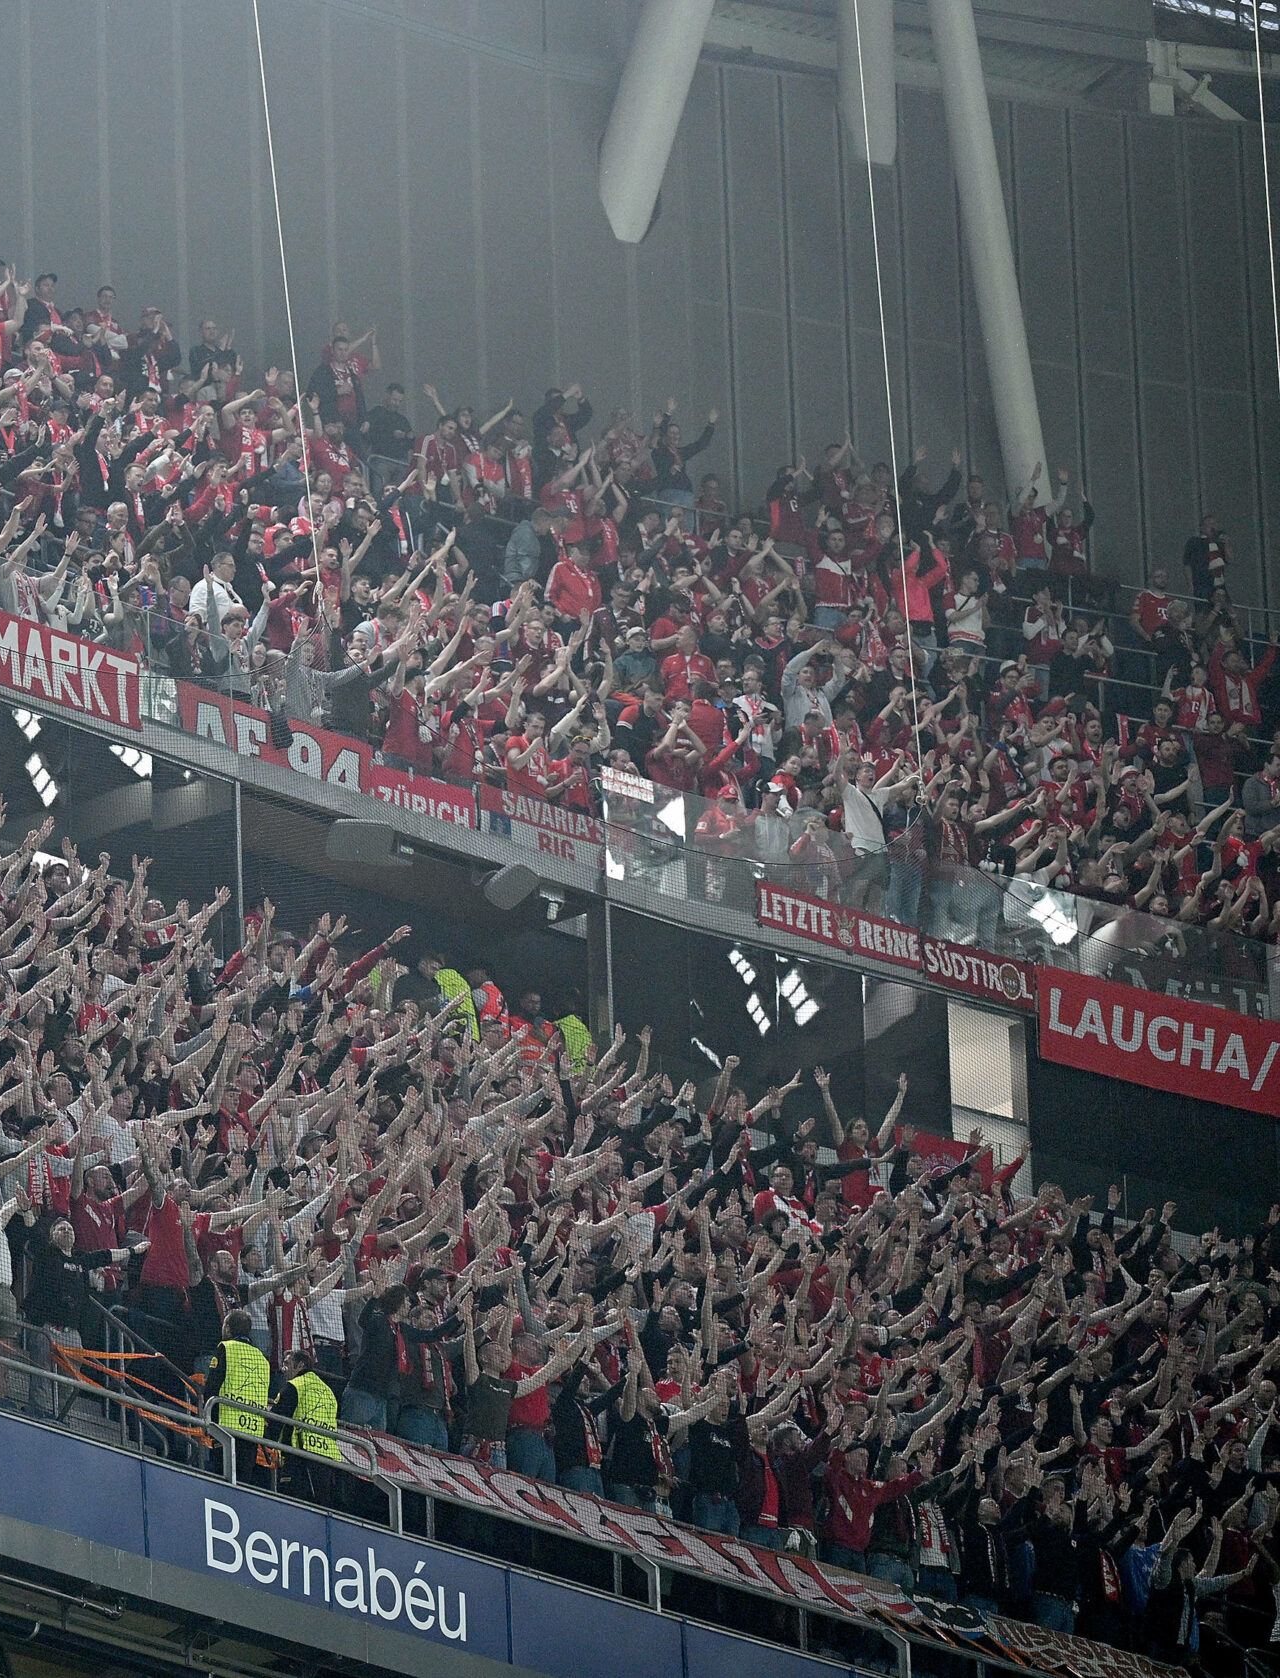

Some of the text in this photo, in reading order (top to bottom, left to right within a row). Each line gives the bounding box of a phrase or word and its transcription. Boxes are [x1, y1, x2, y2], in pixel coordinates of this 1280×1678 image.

[761, 888, 920, 962] LETZTE REINE
[238, 1415, 258, 1432] 013
[308, 1435, 328, 1451] 056
[204, 1498, 467, 1642] Bernabéu
